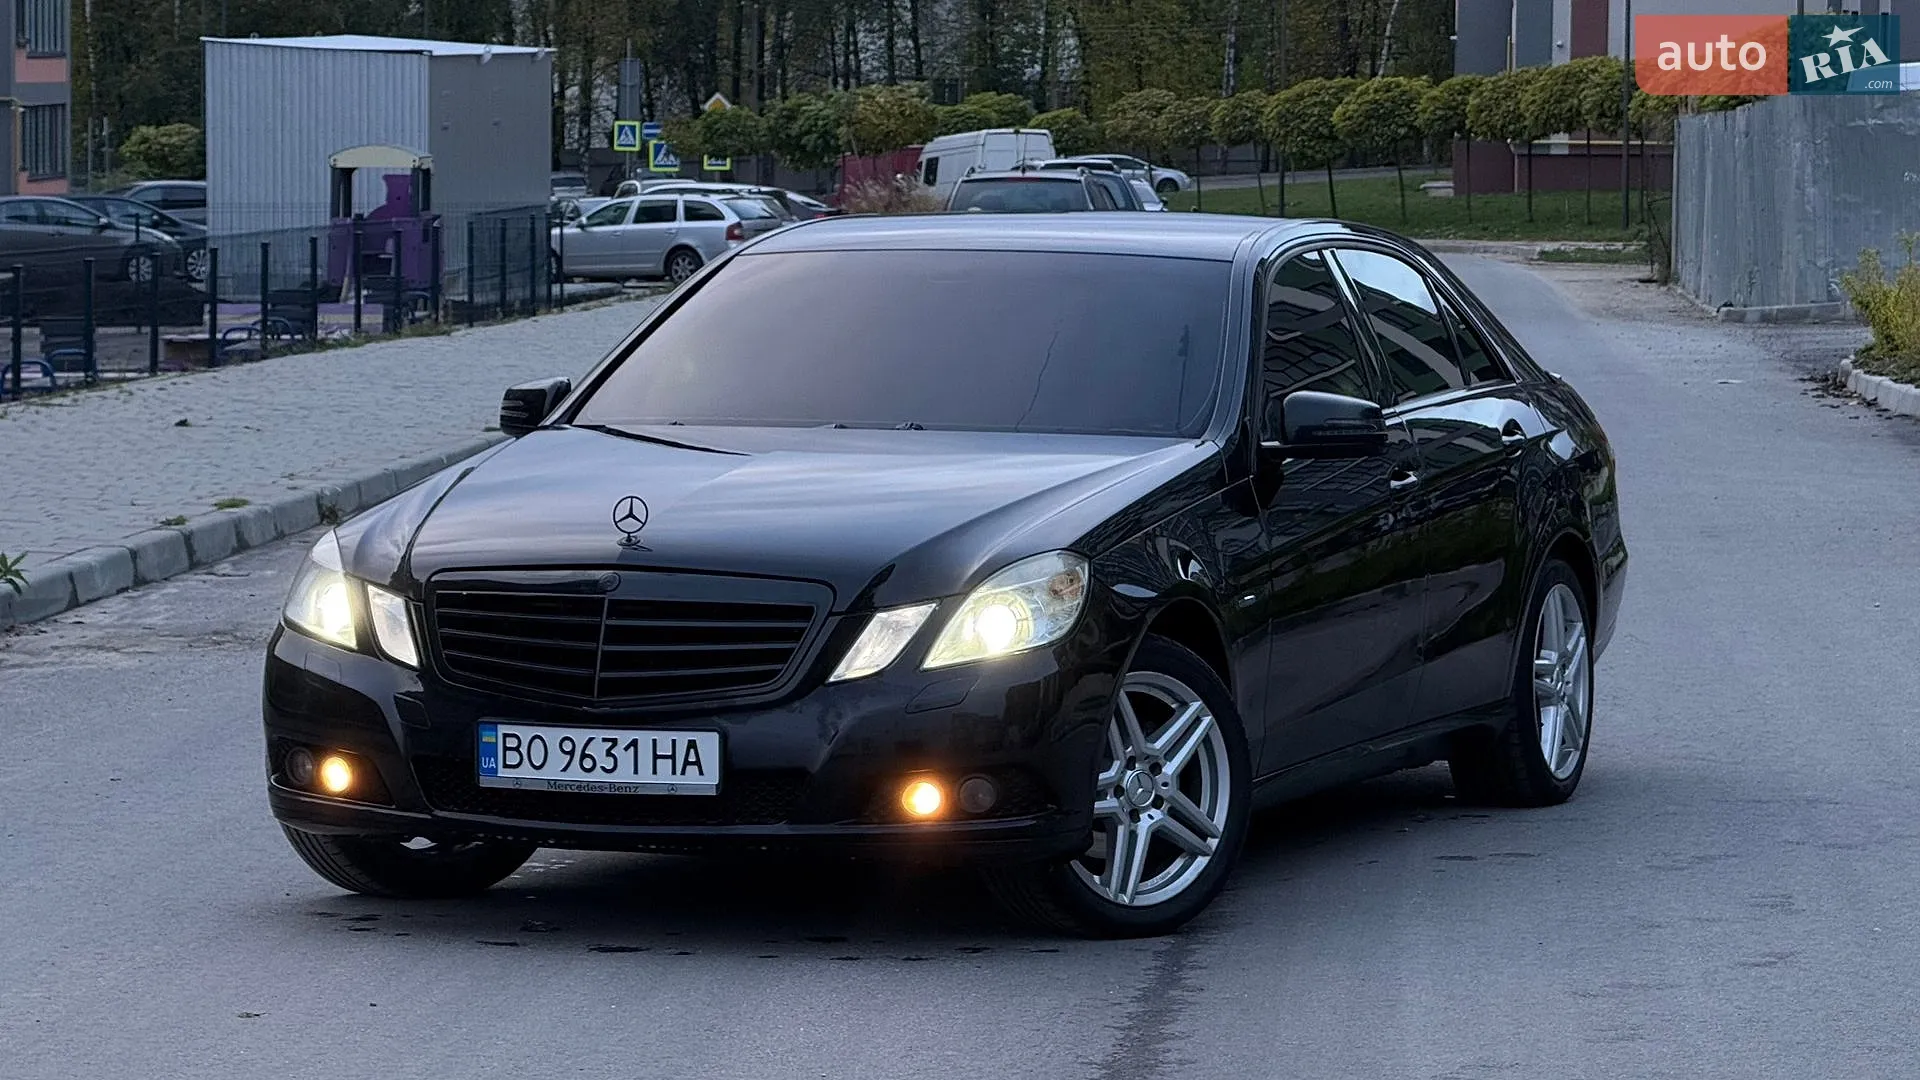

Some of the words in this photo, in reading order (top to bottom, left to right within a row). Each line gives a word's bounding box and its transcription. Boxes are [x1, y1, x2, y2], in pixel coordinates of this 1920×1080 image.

[502, 732, 549, 771] BO
[558, 735, 640, 775] 9631
[651, 738, 705, 776] HA
[482, 757, 496, 769] UA
[547, 781, 640, 794] Mercedes-Benz
